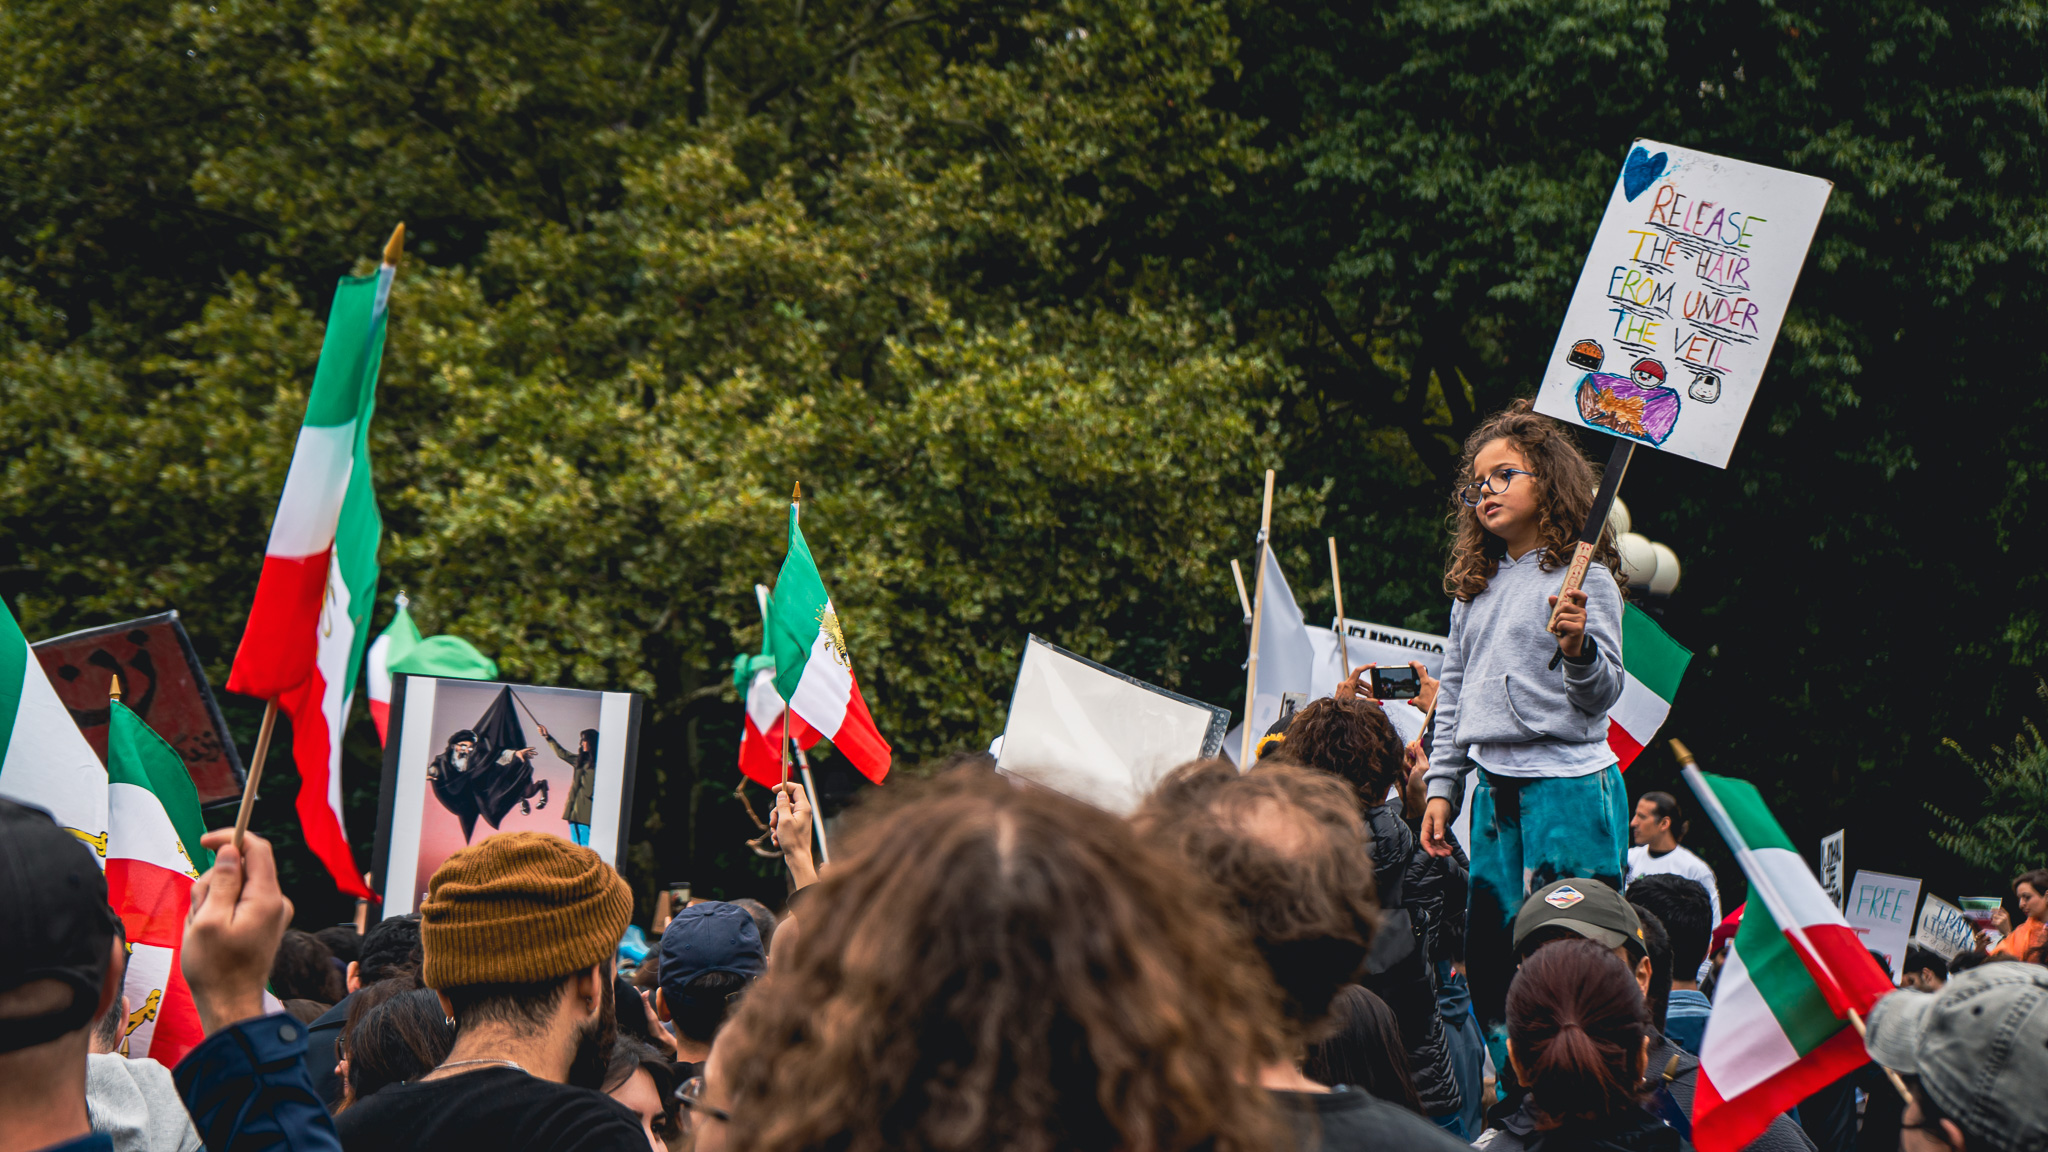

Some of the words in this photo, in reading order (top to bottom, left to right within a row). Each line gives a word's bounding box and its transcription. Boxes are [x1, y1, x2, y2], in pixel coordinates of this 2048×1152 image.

[1648, 185, 1767, 248] RELEASE
[1628, 230, 1681, 267] THE
[1697, 250, 1750, 289] HAIR
[1608, 266, 1676, 313] FROM
[1683, 291, 1760, 334] UNDER
[1609, 308, 1661, 346] THE
[1675, 327, 1733, 374] VEIL
[1856, 884, 1911, 925] FREE
[1936, 901, 1973, 937] IRAN
